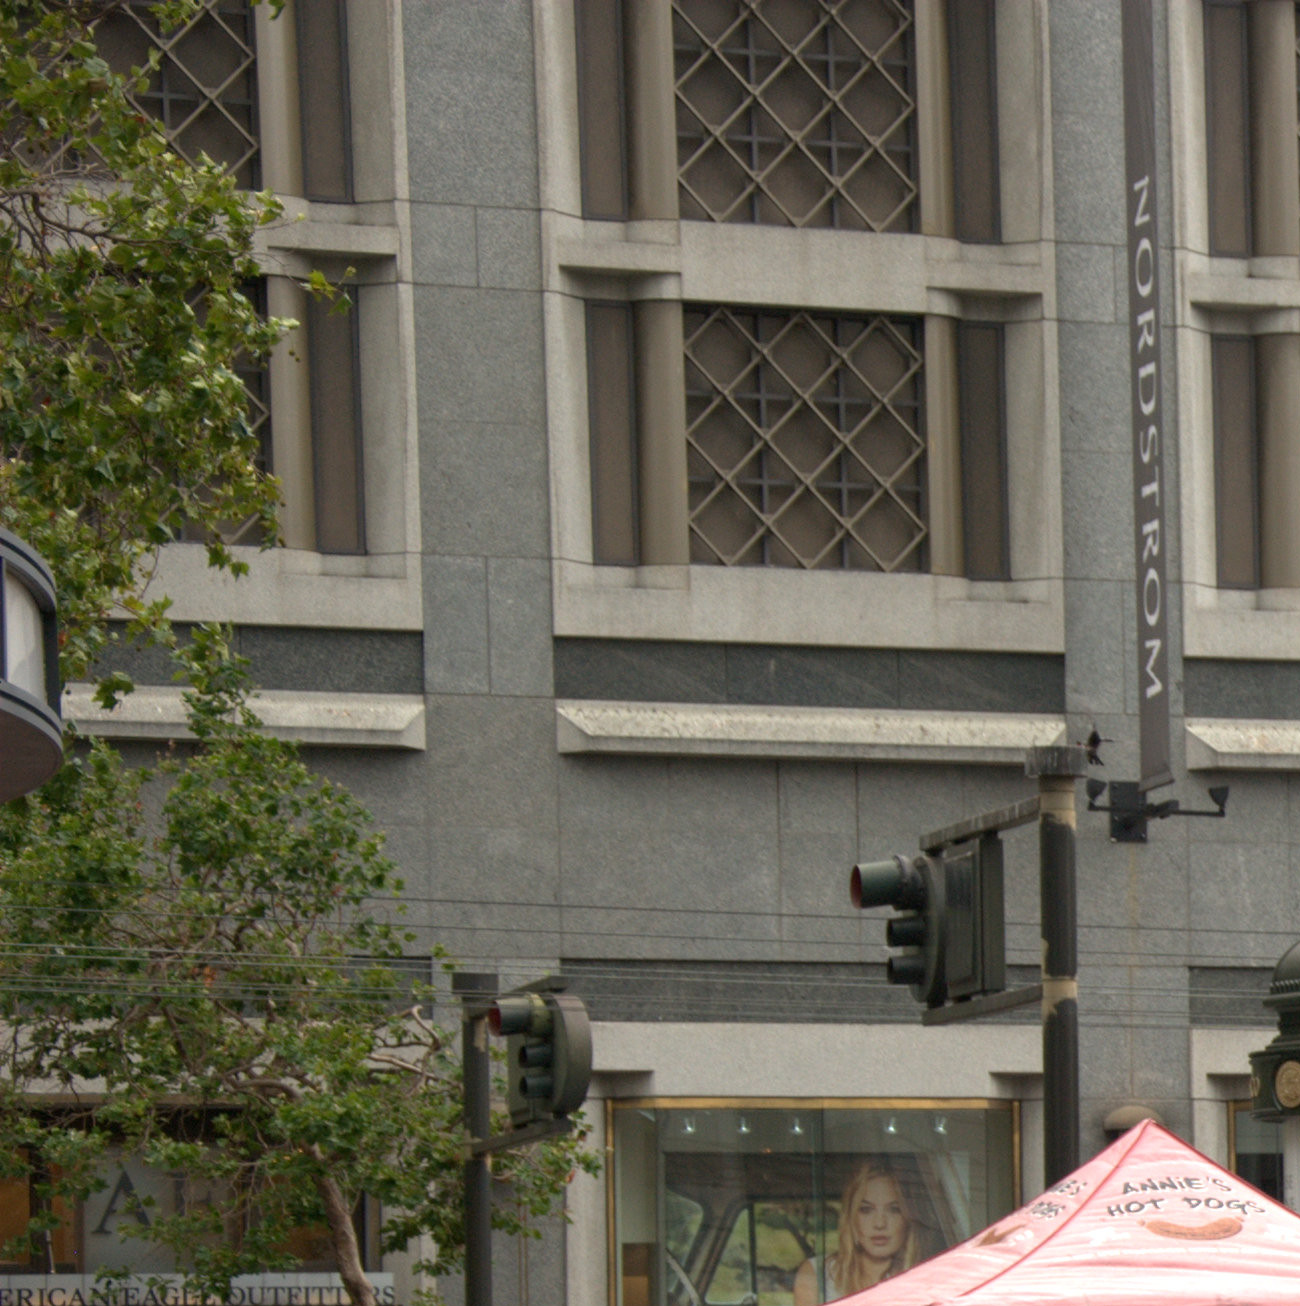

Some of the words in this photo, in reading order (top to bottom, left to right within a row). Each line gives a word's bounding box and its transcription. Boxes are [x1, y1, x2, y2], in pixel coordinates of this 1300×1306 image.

[1133, 175, 1163, 698] NORDSTROM
[1107, 1199, 1165, 1217] HOT
[1182, 1197, 1266, 1215] DOGS
